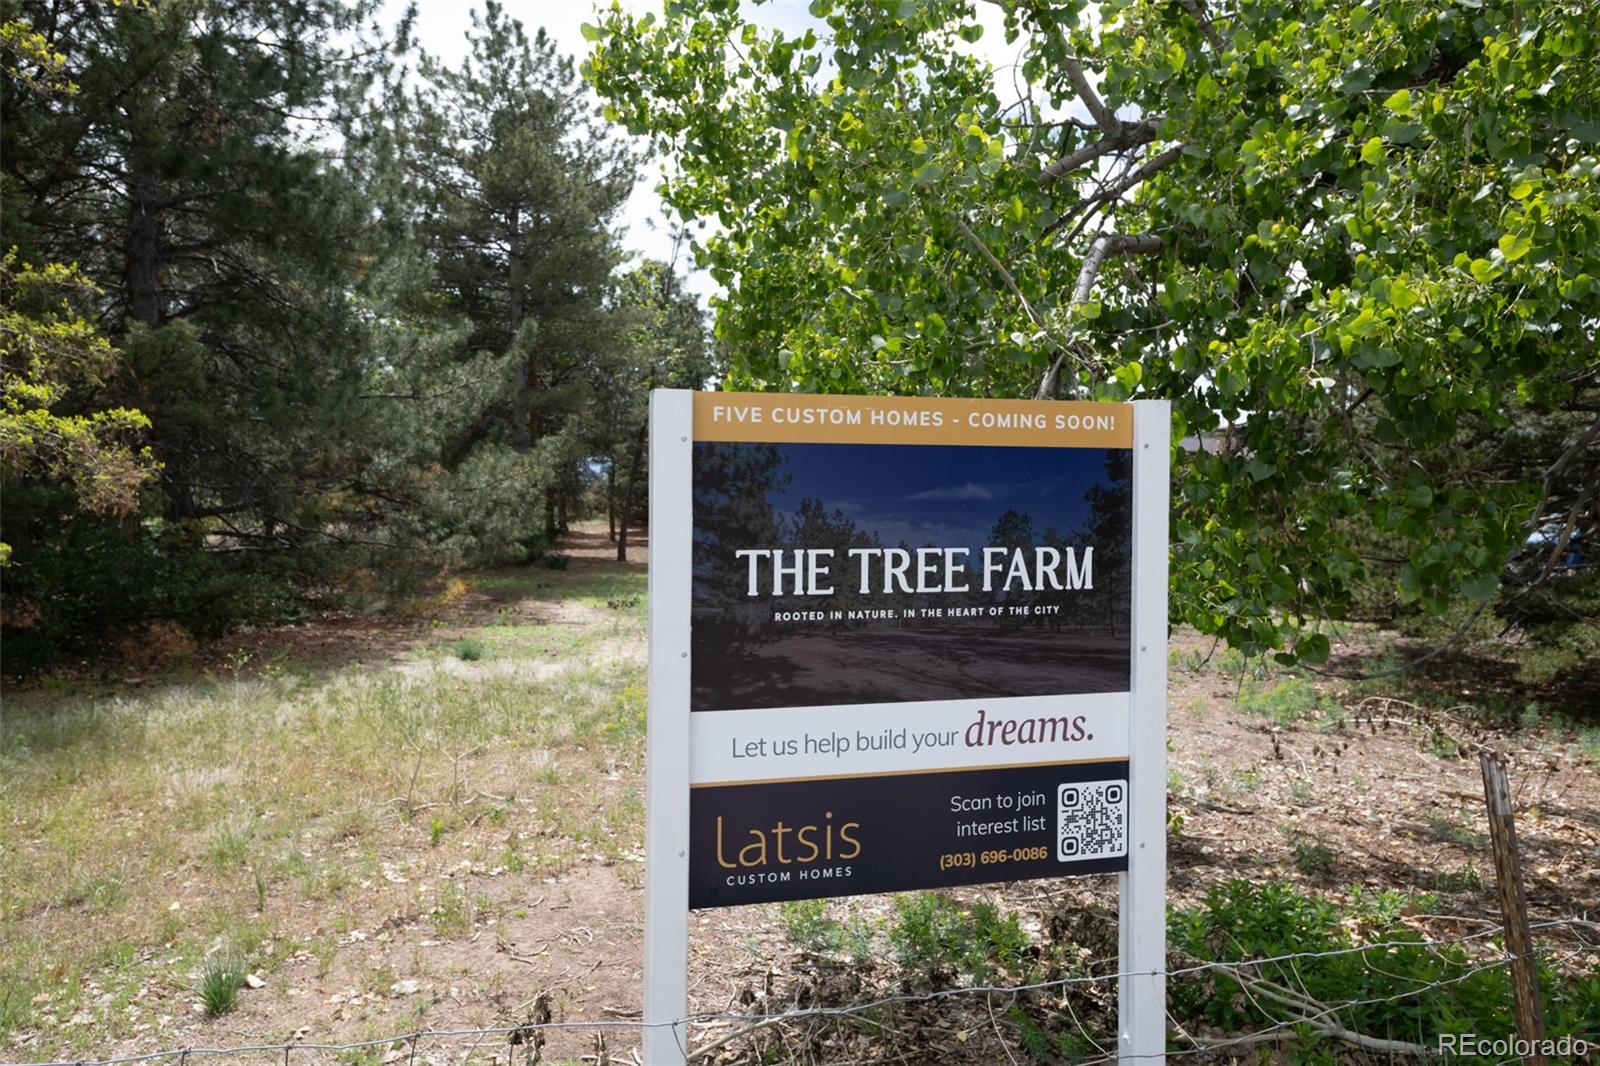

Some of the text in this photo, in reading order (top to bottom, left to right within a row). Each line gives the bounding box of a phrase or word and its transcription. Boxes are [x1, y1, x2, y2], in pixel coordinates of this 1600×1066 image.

[713, 405, 762, 423] FIVE
[771, 407, 862, 425] CUSTOM
[871, 410, 944, 427] HOMES
[968, 412, 1048, 429] COMING
[1055, 414, 1115, 430] SOON!
[735, 546, 1094, 596] THE TREE FARM
[775, 610, 825, 622] ROOTED
[830, 610, 842, 621] IN
[903, 609, 915, 618] IN
[920, 608, 942, 618] THE
[948, 607, 984, 617] HEART
[989, 607, 1003, 616] OF
[1008, 606, 1030, 616] THE
[1034, 605, 1060, 615] CITY
[732, 710, 1094, 759] Let us help build your dreams.
[950, 791, 1046, 812] Scan to join
[957, 814, 1046, 837] interest list
[939, 846, 1048, 871] (303) 696-0086
[726, 866, 852, 886] CUSTOM HOMES
